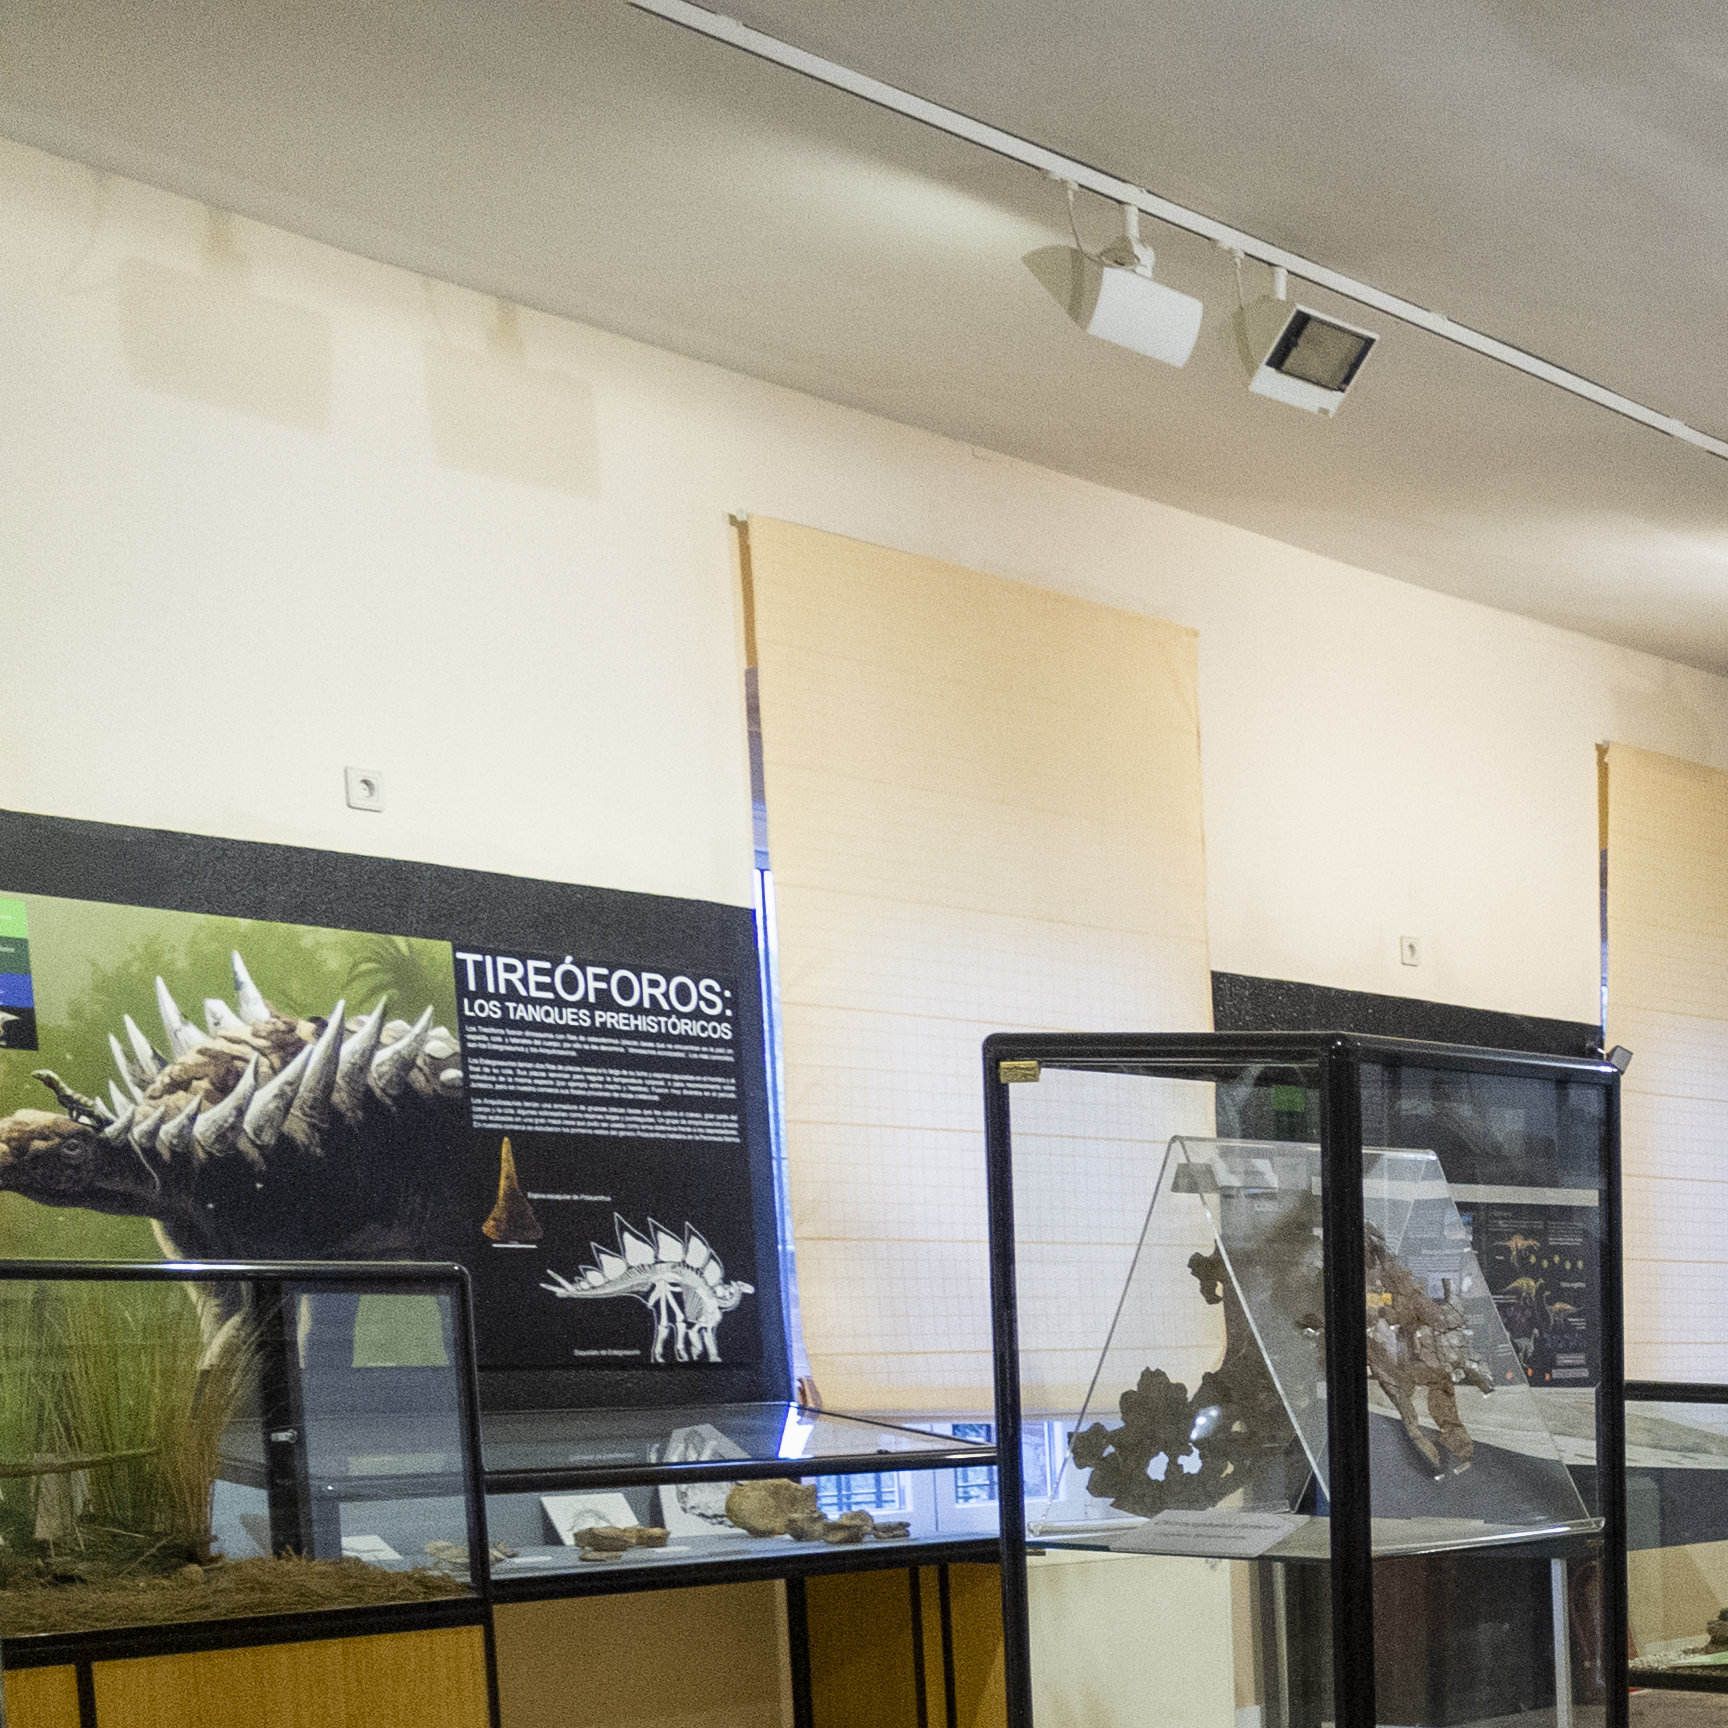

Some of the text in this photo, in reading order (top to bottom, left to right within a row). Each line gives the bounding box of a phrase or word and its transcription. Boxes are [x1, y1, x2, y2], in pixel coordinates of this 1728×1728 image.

[455, 952, 733, 1017] TIREÓFOROS:
[464, 998, 732, 1040] LOS TANQUES PREHISTÓRICOS
